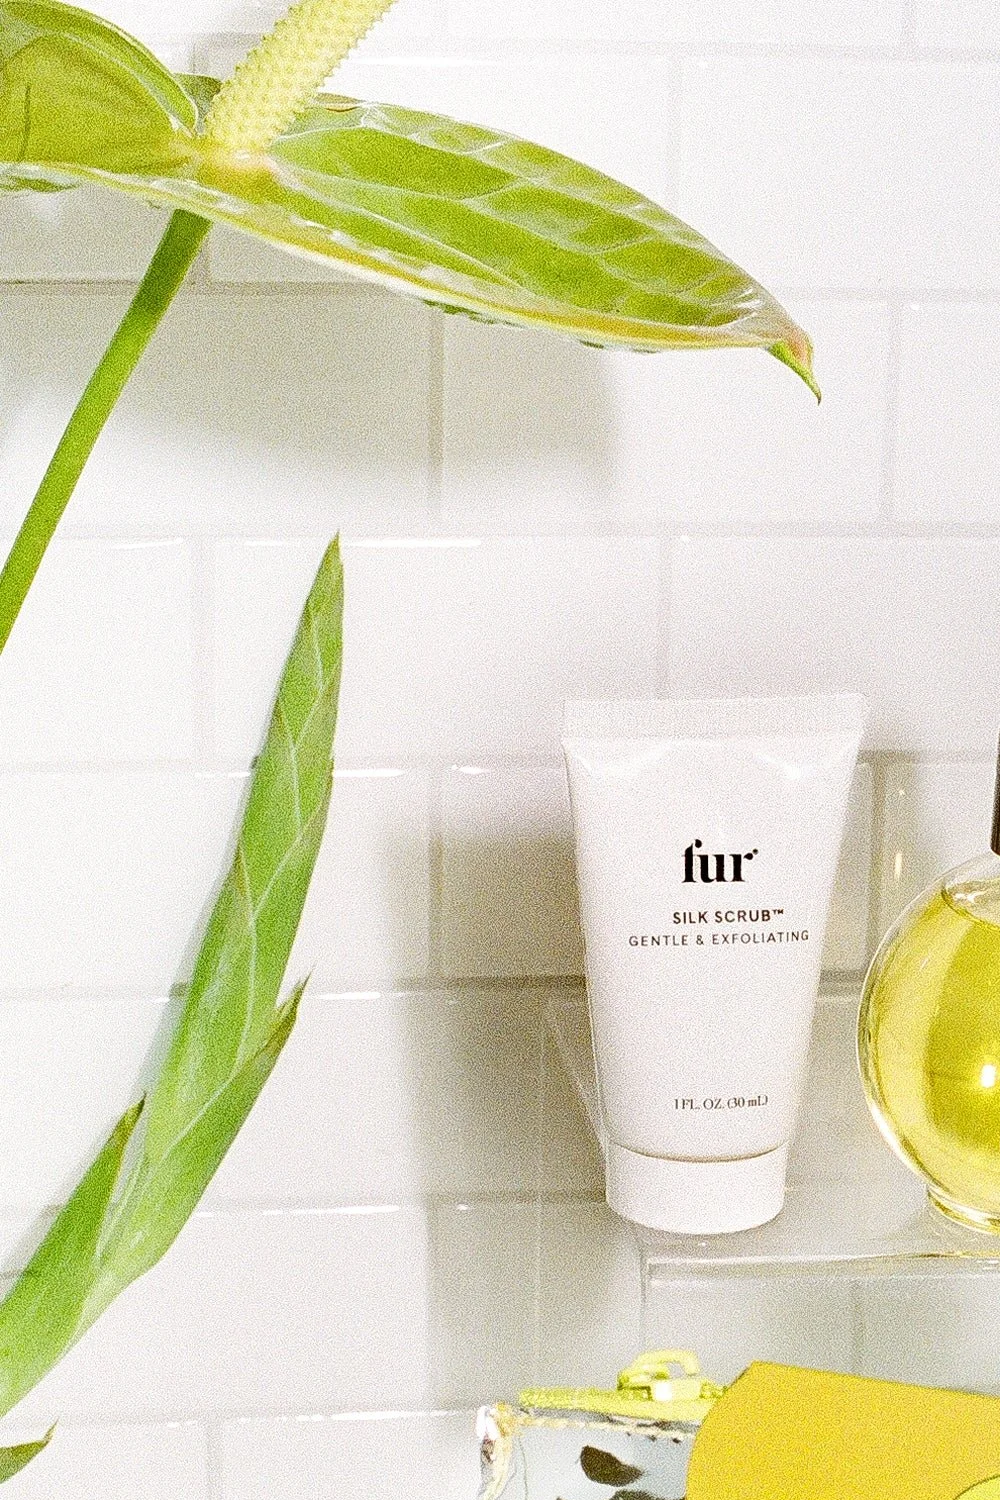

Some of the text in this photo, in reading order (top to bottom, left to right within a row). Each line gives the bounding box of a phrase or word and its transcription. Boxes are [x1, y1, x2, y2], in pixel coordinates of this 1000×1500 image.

[681, 838, 756, 883] fur
[673, 910, 708, 924] SILK
[629, 930, 809, 947] GENTLE & EXFOLIATING
[703, 1097, 724, 1110] OZ.
